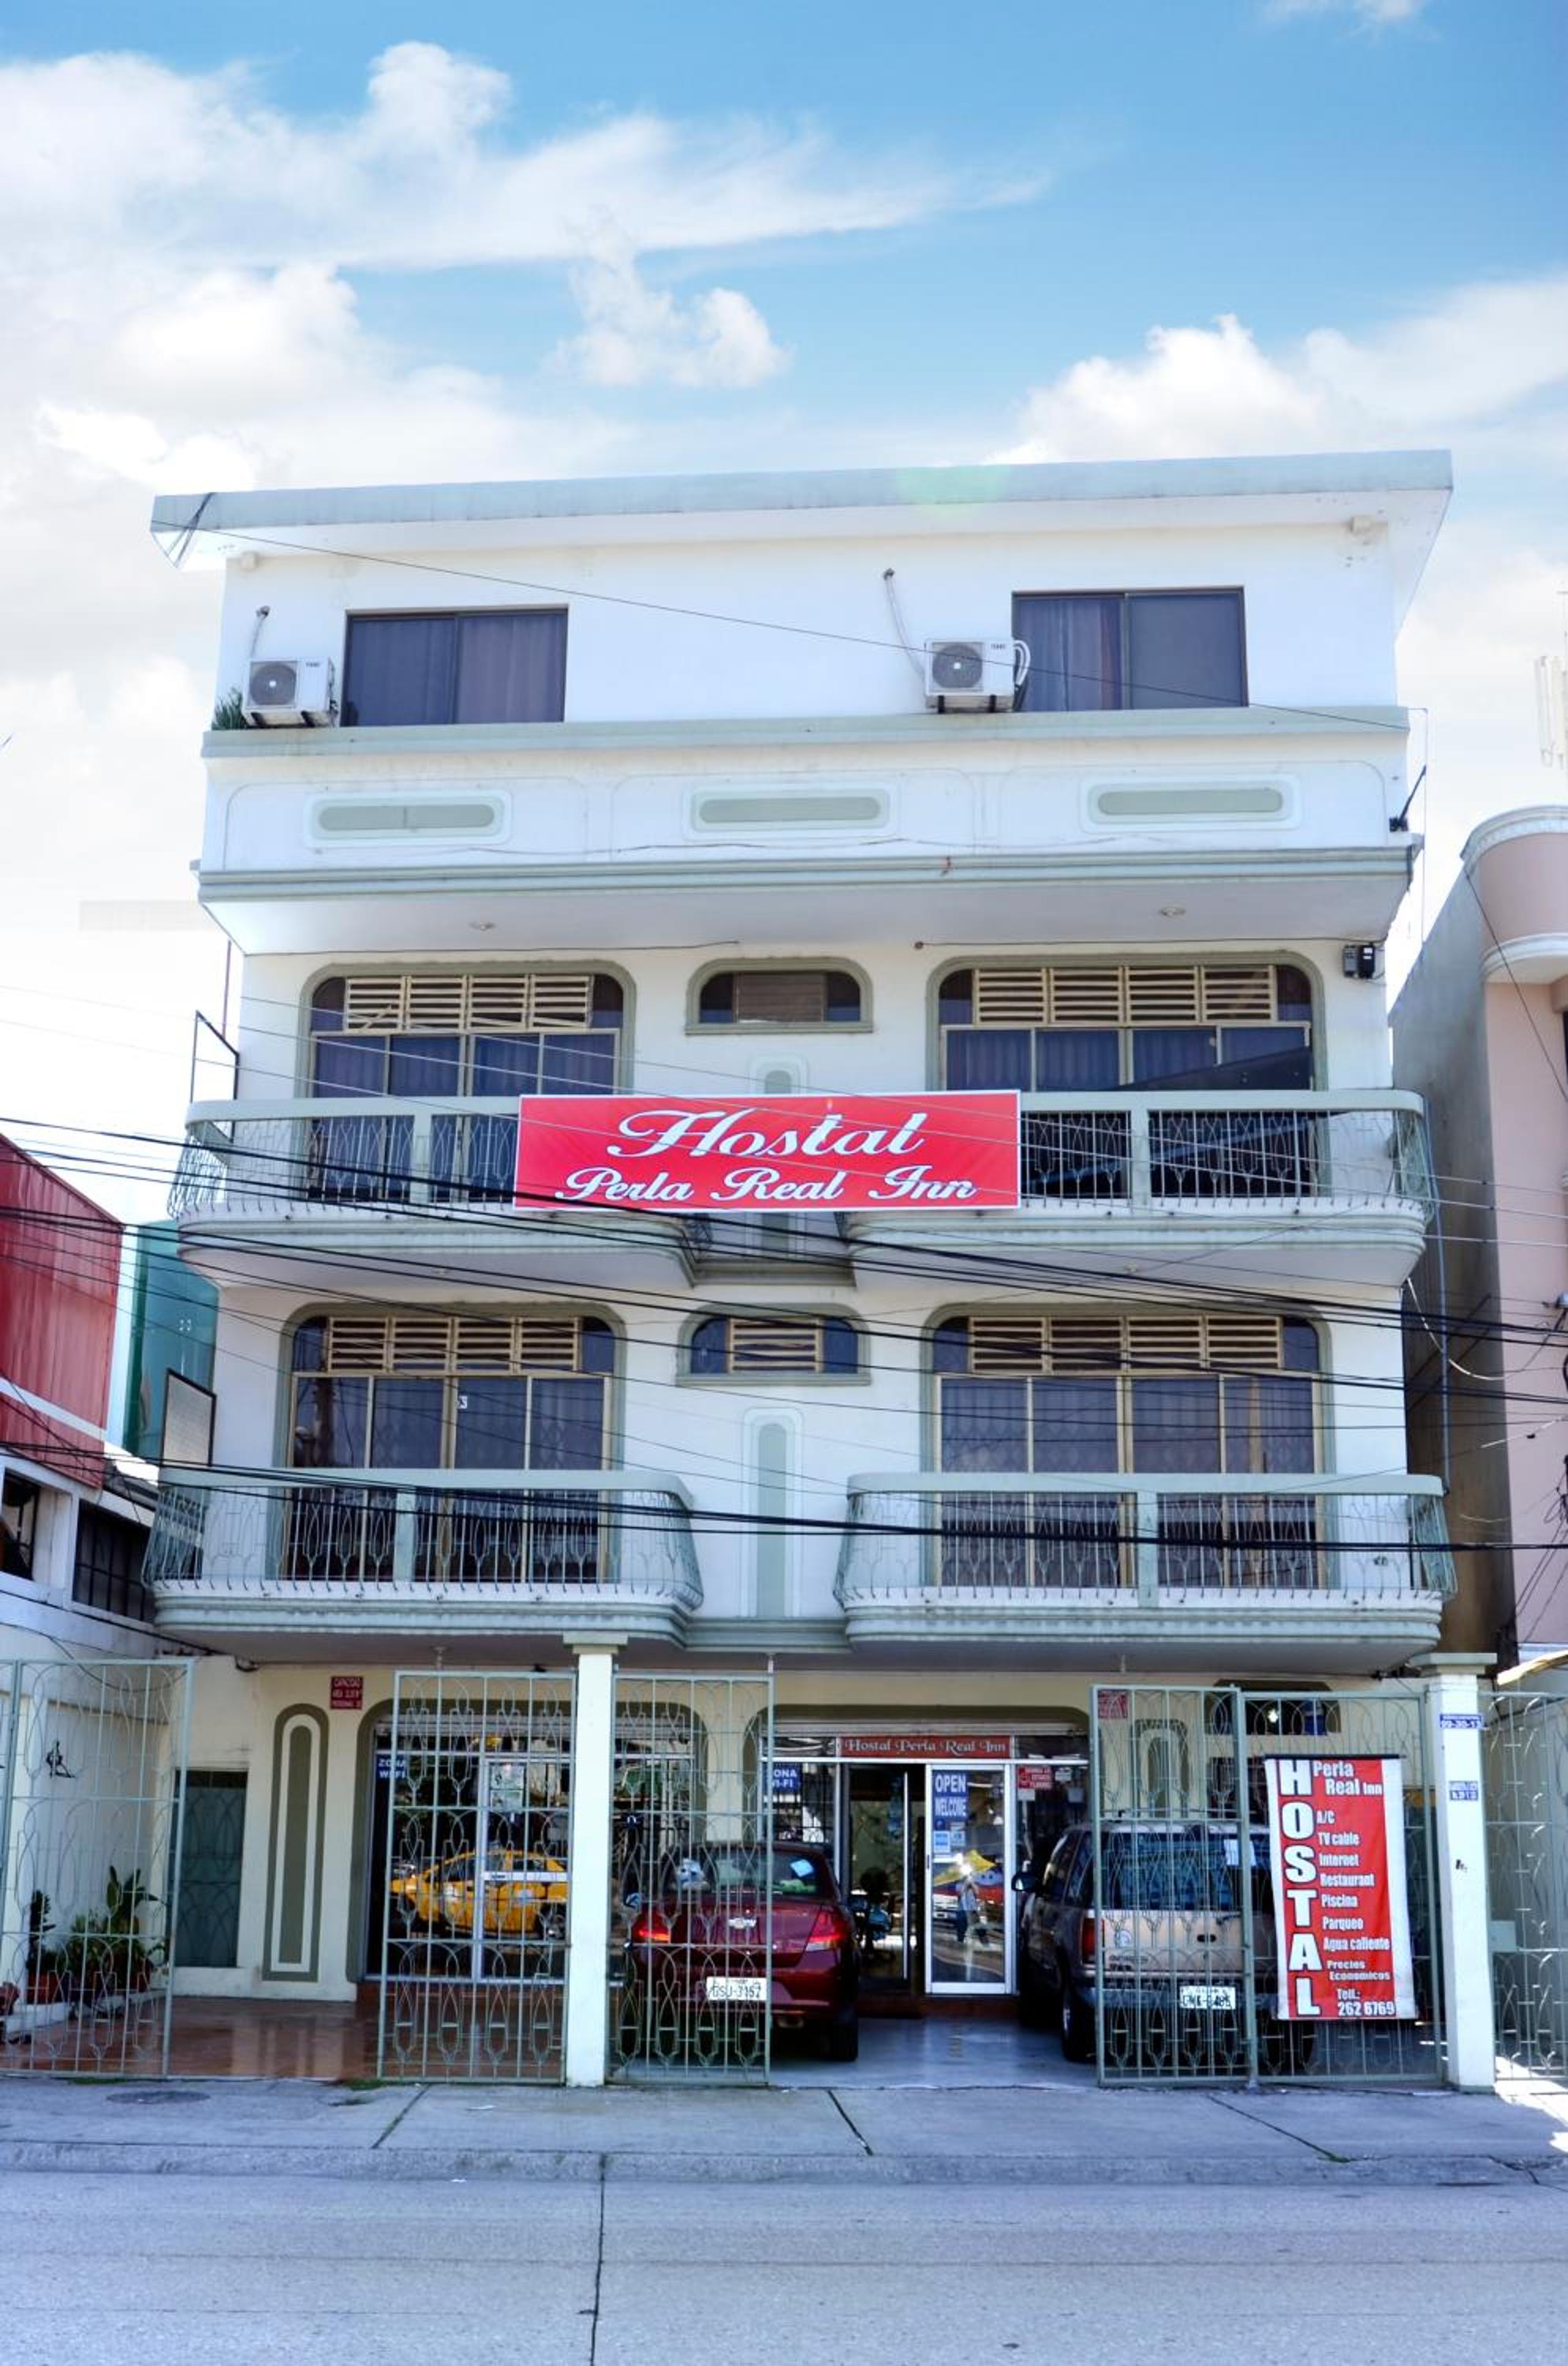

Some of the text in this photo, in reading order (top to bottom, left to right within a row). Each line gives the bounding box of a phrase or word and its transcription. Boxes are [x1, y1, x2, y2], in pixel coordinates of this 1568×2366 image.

[607, 1107, 928, 1158] Hostal
[554, 1165, 977, 1200] Perla Real Inn
[845, 1738, 1006, 1756] Hostal Perla Real Inn
[771, 1769, 797, 1778] ONA
[1312, 1760, 1354, 1777] Perla
[935, 1774, 966, 1793] OPEN
[1325, 1778, 1361, 1796] Real
[1316, 1809, 1336, 1824] A/C
[1317, 1831, 1361, 1845] TV cable
[1319, 1853, 1359, 1867] Internet
[1320, 1873, 1375, 1887] Restaurant
[1321, 1894, 1358, 1908] Piscina
[1323, 1916, 1364, 1931] Parqueo
[1323, 1936, 1391, 1952] Agua caliente
[1326, 1960, 1366, 1969] Precios
[1338, 2001, 1395, 2017] 262 6769
